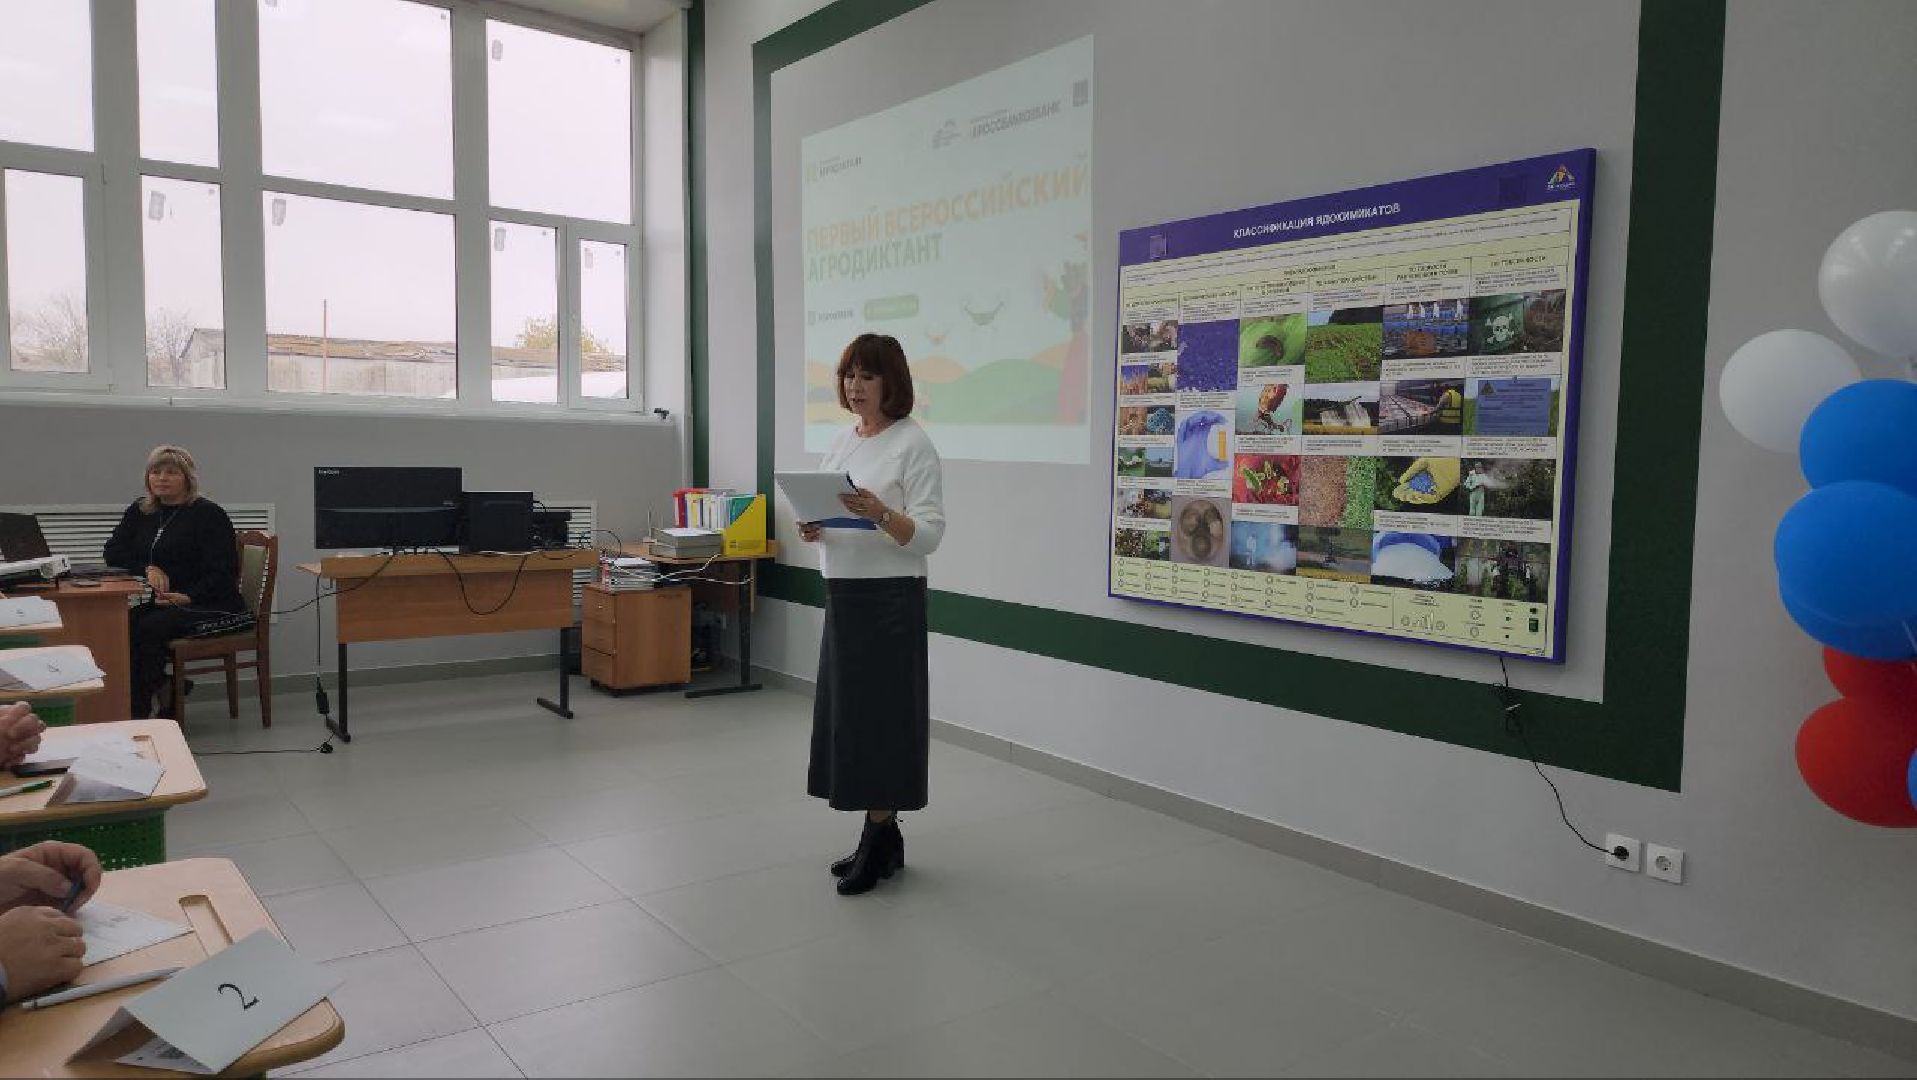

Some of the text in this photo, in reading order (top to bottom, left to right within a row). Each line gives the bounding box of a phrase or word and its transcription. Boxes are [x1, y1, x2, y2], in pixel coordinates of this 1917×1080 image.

[807, 152, 1089, 251] ПЕРВЫЙ ВСЕРОССИЙСКИЙ
[1233, 202, 1401, 239] КЛАССИФИКАЦИЯ ЯДОХИМИКАТОВ
[809, 234, 943, 281] АГРОДИКТАНТ
[217, 983, 260, 1012] 2
